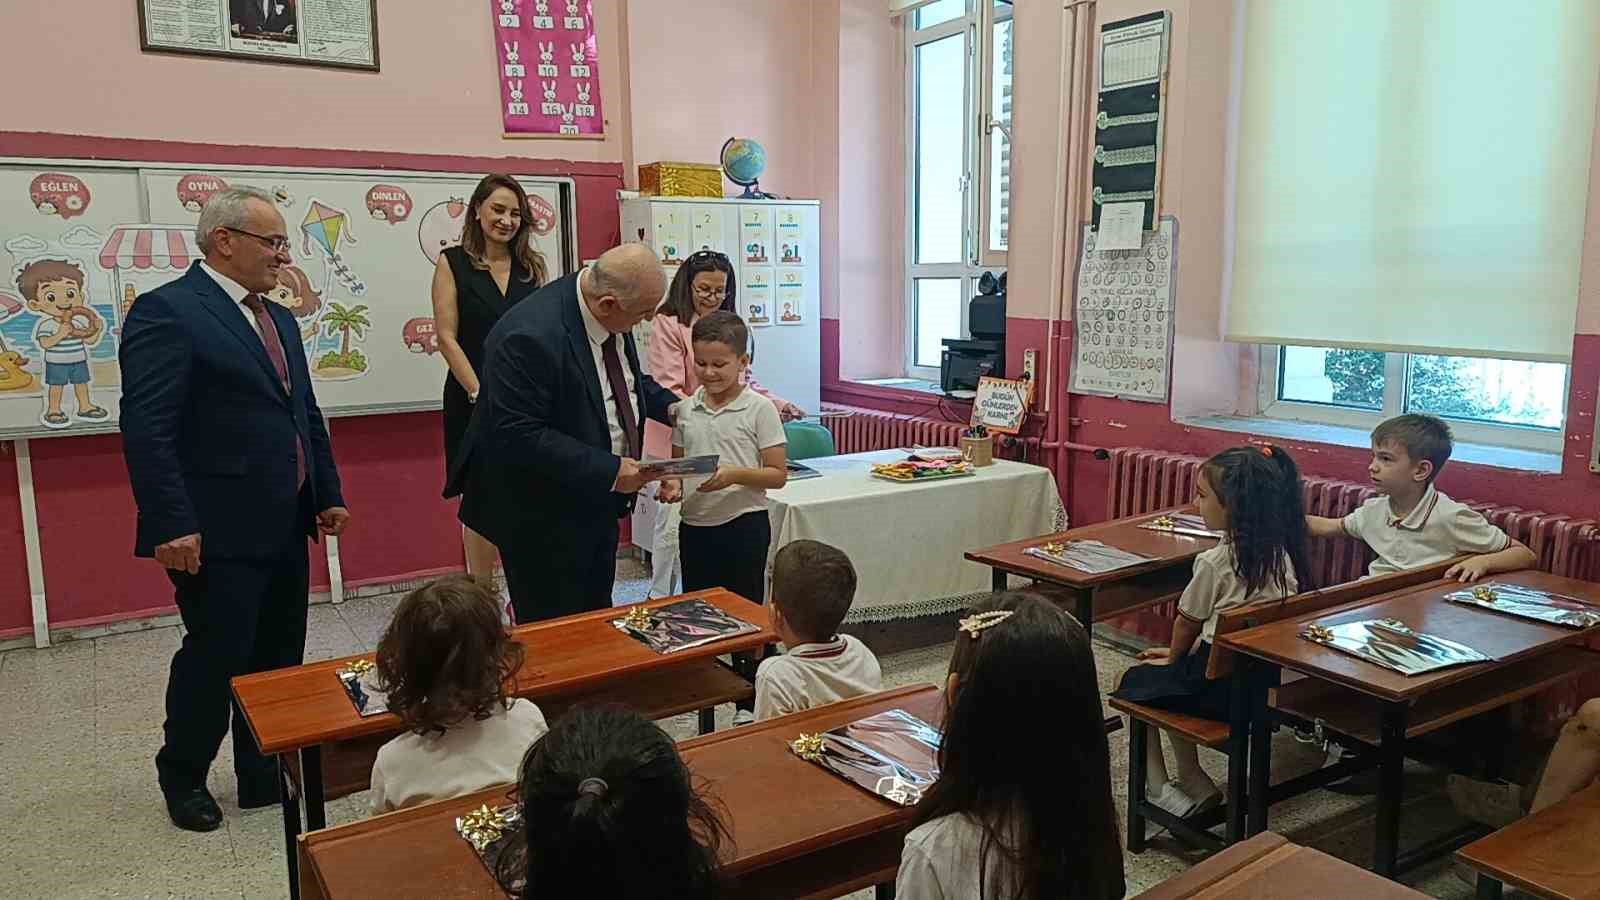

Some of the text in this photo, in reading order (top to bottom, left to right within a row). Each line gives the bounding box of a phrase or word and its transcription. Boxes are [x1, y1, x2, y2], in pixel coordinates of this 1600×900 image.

[505, 17, 512, 26] 2
[540, 18, 546, 27] 4
[571, 19, 578, 29] 6
[511, 67, 519, 75] 8
[542, 67, 554, 76] 10
[575, 67, 586, 76] 12
[513, 105, 525, 114] 14
[546, 105, 558, 115] 16
[580, 107, 591, 117] 18
[40, 180, 79, 192] EĞLEN
[188, 181, 219, 191] OYNA
[372, 191, 406, 201] DİNLEN
[705, 214, 711, 223] 2
[753, 213, 759, 222] 7
[755, 274, 761, 283] 9
[786, 274, 795, 283] 10
